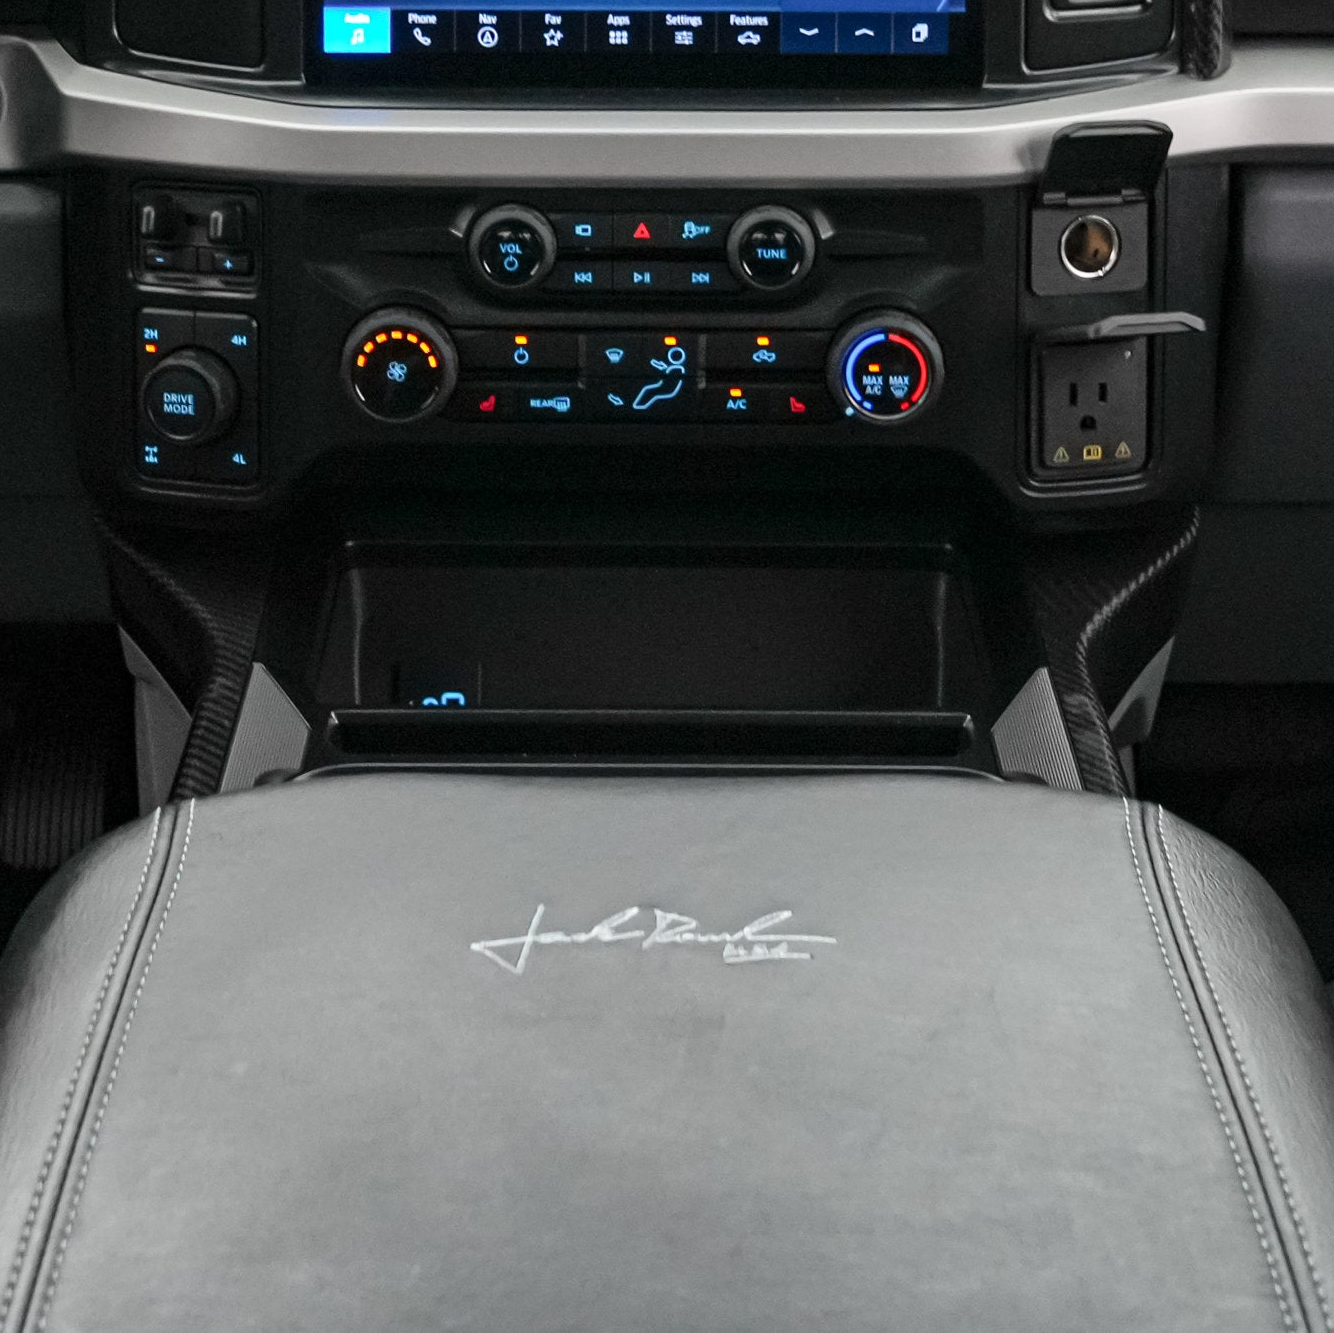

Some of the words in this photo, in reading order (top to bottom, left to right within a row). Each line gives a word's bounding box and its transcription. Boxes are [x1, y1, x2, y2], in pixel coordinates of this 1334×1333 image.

[408, 13, 437, 26] Phone
[479, 13, 497, 25] Nav
[545, 13, 562, 26] Fav
[607, 14, 630, 27] Apps
[666, 14, 703, 27] Settings
[730, 14, 769, 26] Features
[499, 243, 523, 255] VOL
[756, 248, 787, 259] TUNE
[143, 328, 159, 340] 2H
[230, 335, 247, 347] 4H
[862, 375, 884, 386] MAX
[889, 375, 910, 386] MAX
[866, 386, 882, 396] A/C
[163, 392, 195, 405] DRIVE
[726, 399, 748, 410] A/C
[163, 403, 195, 416] MODE
[232, 453, 247, 465] 4L
